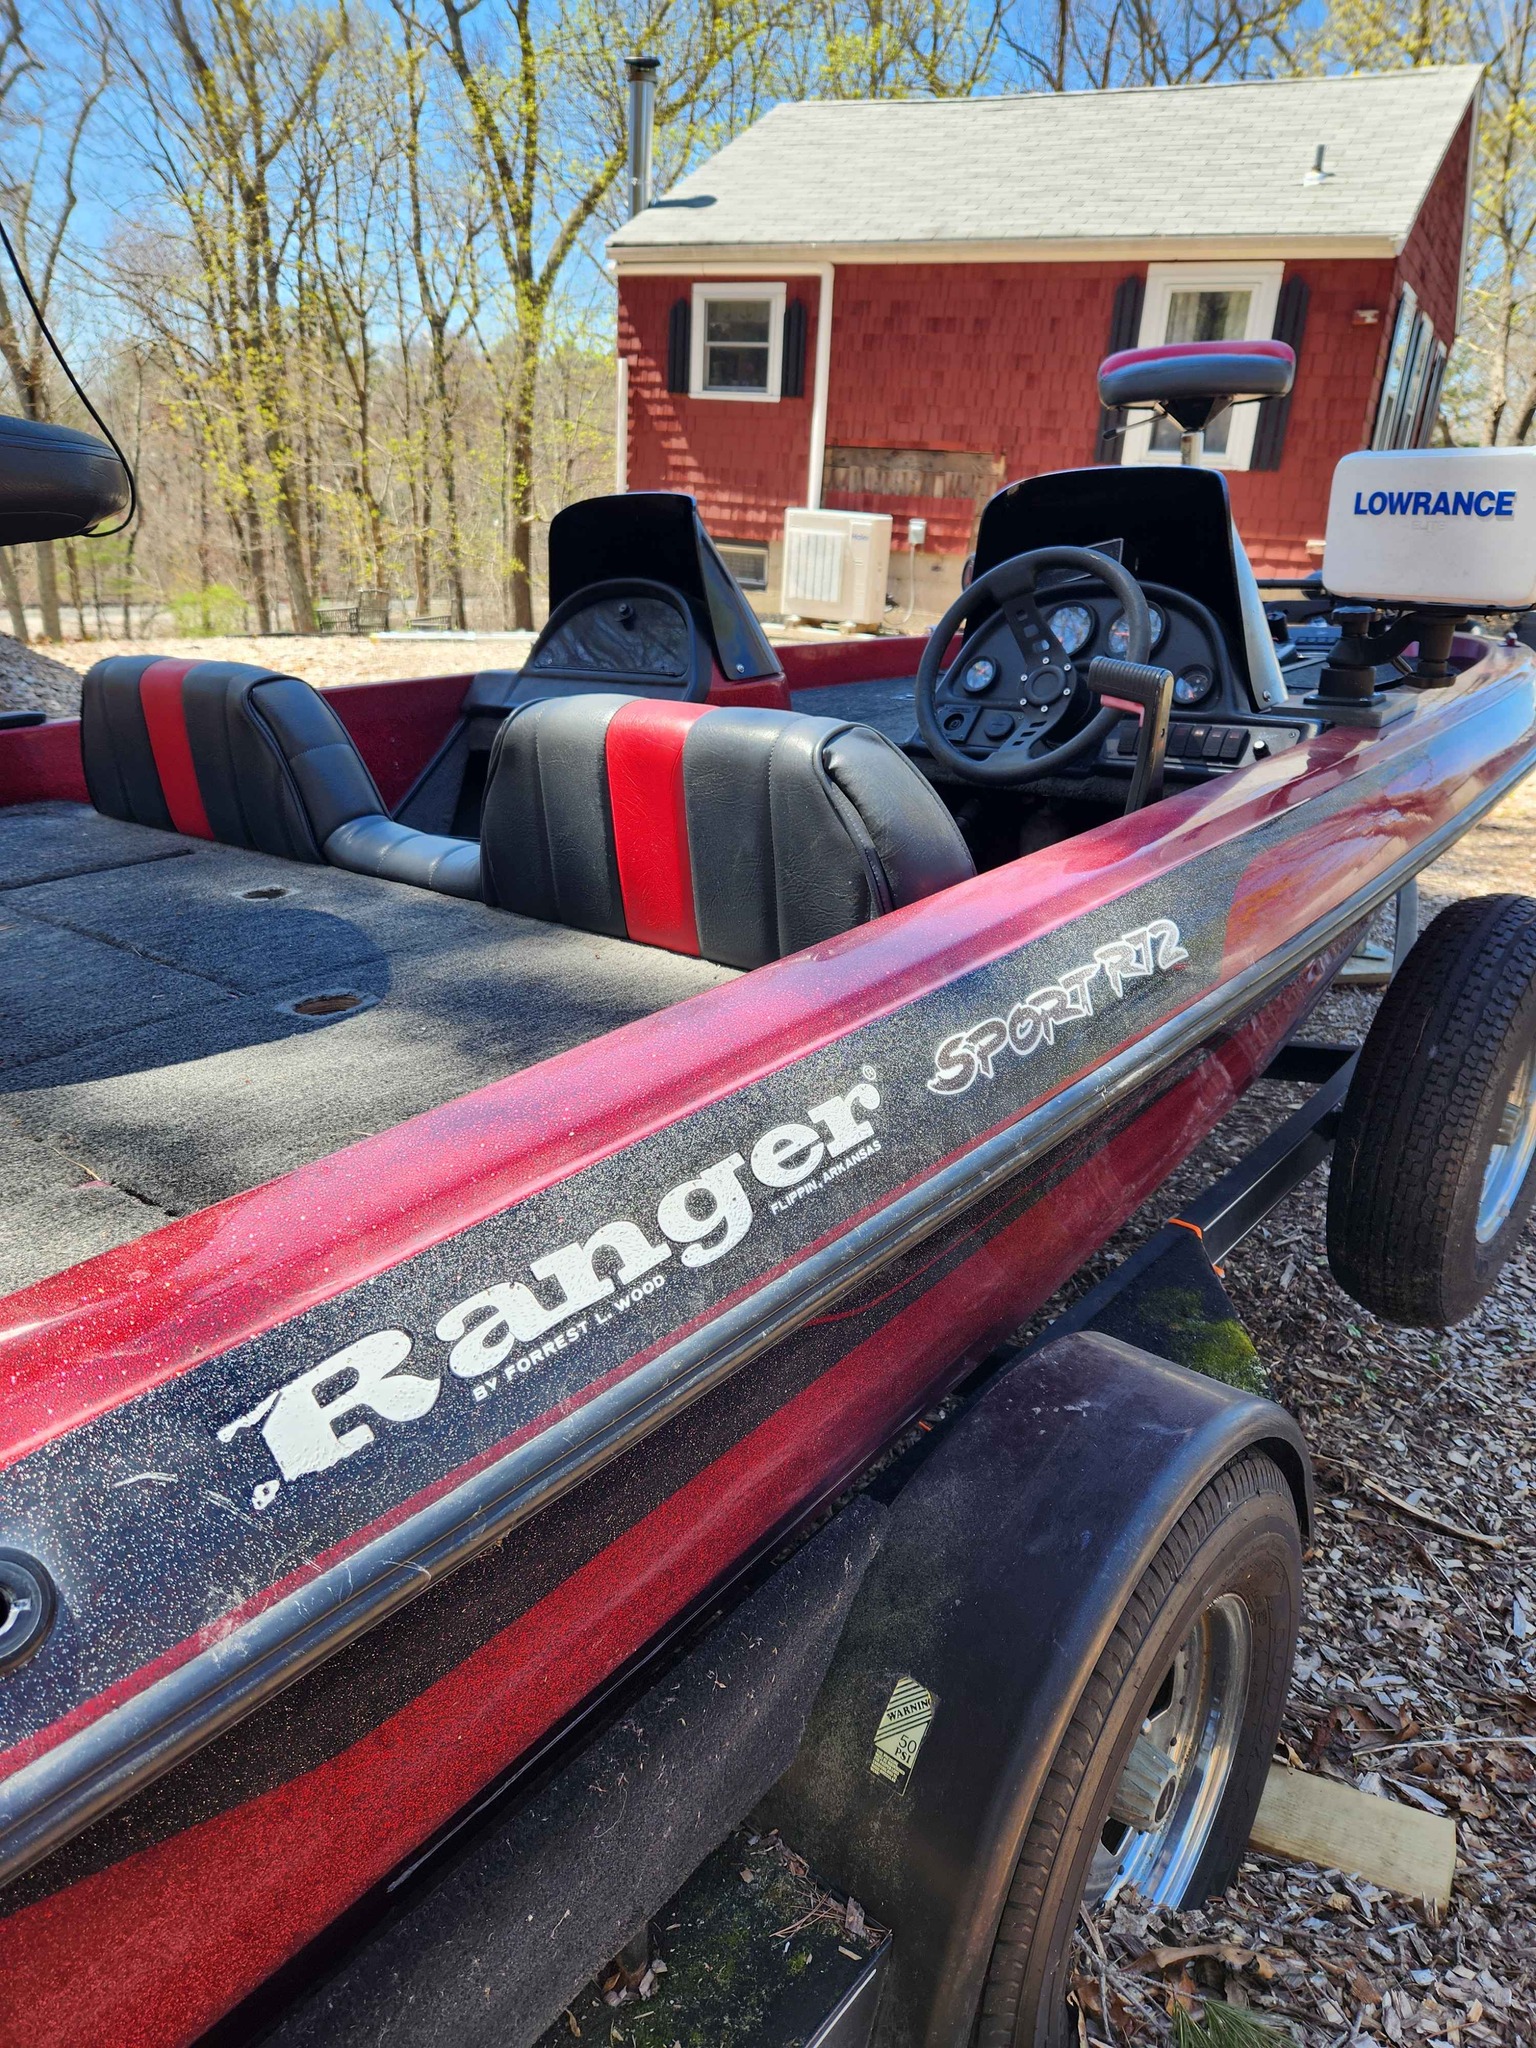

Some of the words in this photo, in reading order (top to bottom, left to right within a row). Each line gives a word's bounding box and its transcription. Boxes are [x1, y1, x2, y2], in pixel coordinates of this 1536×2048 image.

[1354, 491, 1517, 517] LOWRANCE
[927, 963, 1101, 1095] SPORT
[823, 1140, 882, 1184] ARKANSAS
[472, 1377, 498, 1402] BY
[504, 1321, 588, 1381] FORREST
[594, 1311, 613, 1325] L.
[613, 1274, 666, 1312] WOOD
[894, 1746, 912, 1764] PSI
[899, 1734, 917, 1754] 50
